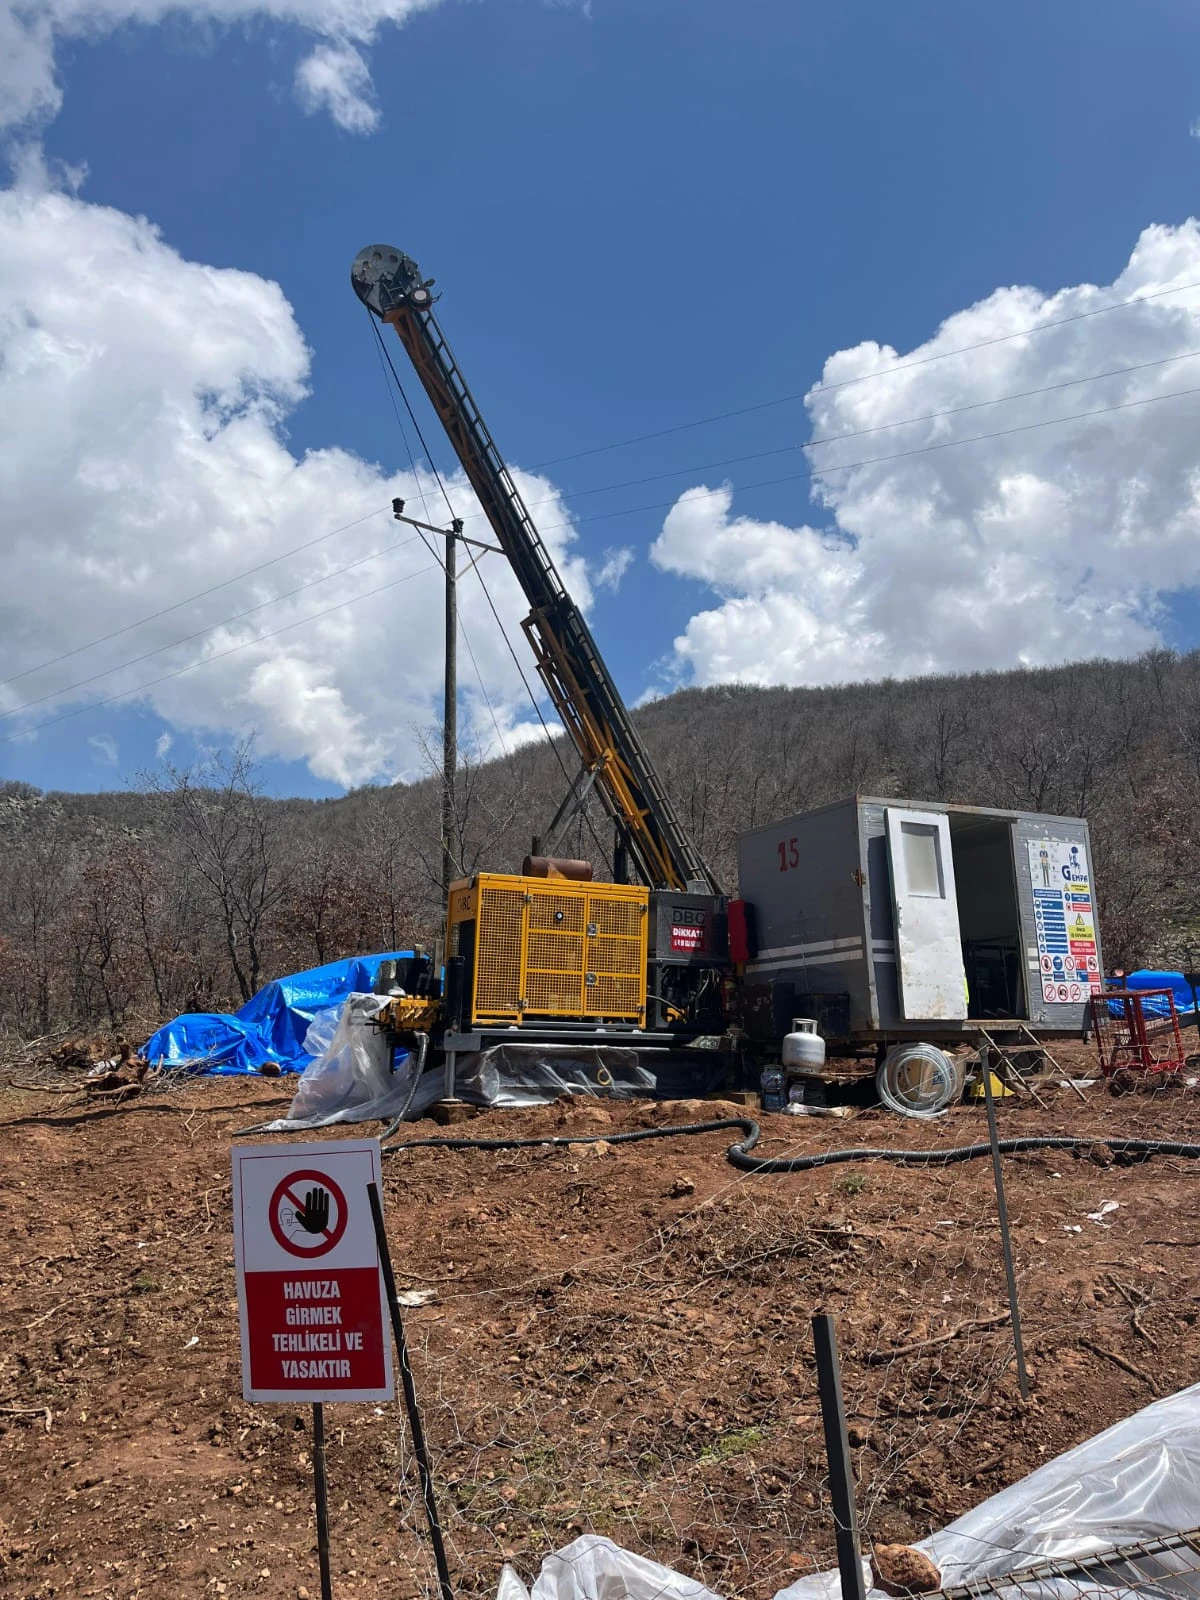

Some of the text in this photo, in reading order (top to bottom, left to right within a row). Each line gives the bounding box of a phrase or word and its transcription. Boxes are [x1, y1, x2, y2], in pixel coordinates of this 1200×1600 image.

[778, 837, 800, 872] 15
[284, 1281, 341, 1300] HAVUZA
[286, 1304, 342, 1325] GİRMEK
[272, 1329, 363, 1352] TEHLİKELİ VE
[281, 1360, 351, 1379] YASAKTIR
